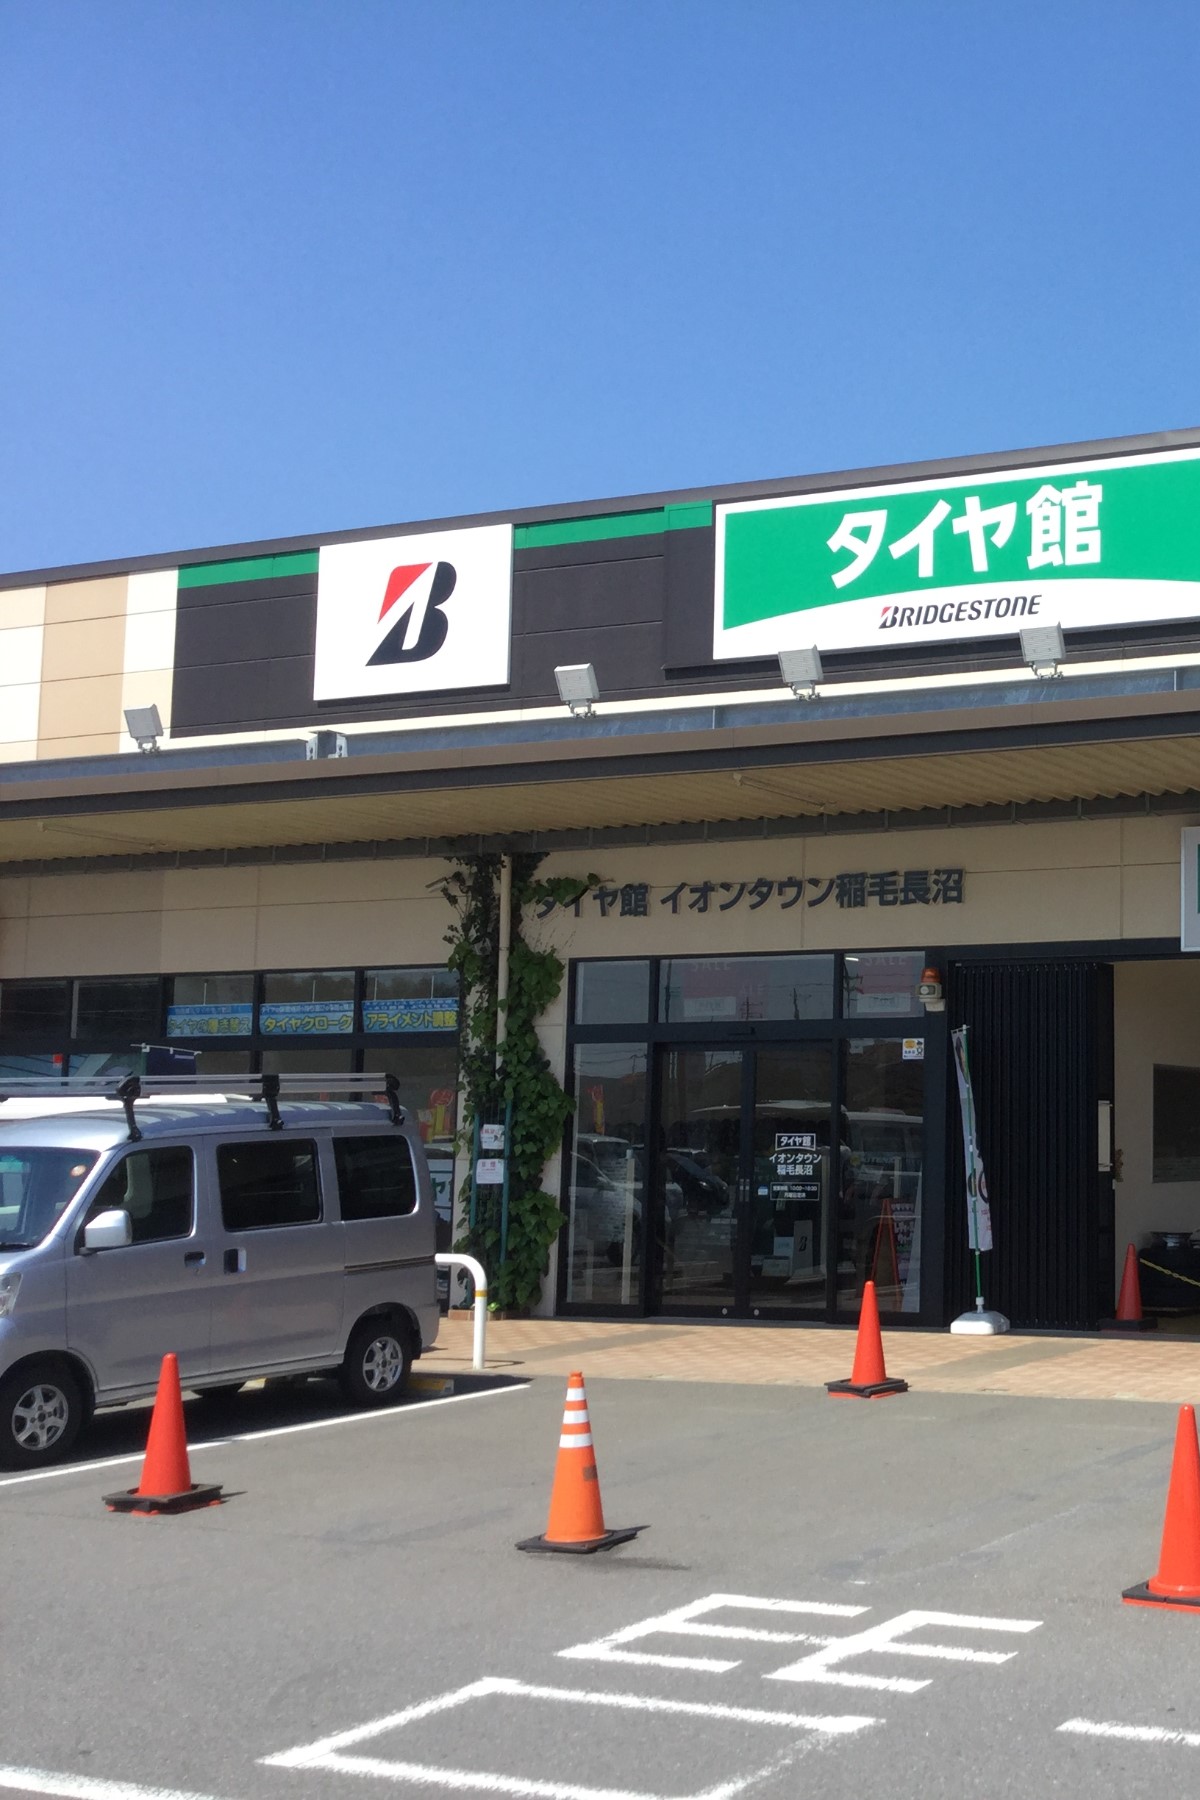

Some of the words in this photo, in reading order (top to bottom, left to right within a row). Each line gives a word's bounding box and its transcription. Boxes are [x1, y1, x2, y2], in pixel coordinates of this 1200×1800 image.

[826, 481, 1103, 590] タイヤ館
[878, 593, 1041, 630] BRIDGESTONE
[660, 867, 965, 912] イオンタウン稲毛長沼
[263, 1014, 354, 1033] タイヤクローク
[366, 1010, 457, 1028] アライメント調整
[780, 1136, 811, 1146] タイヤ館
[769, 1153, 822, 1163] イオンタウン
[777, 1164, 813, 1175] 稲毛長沼
